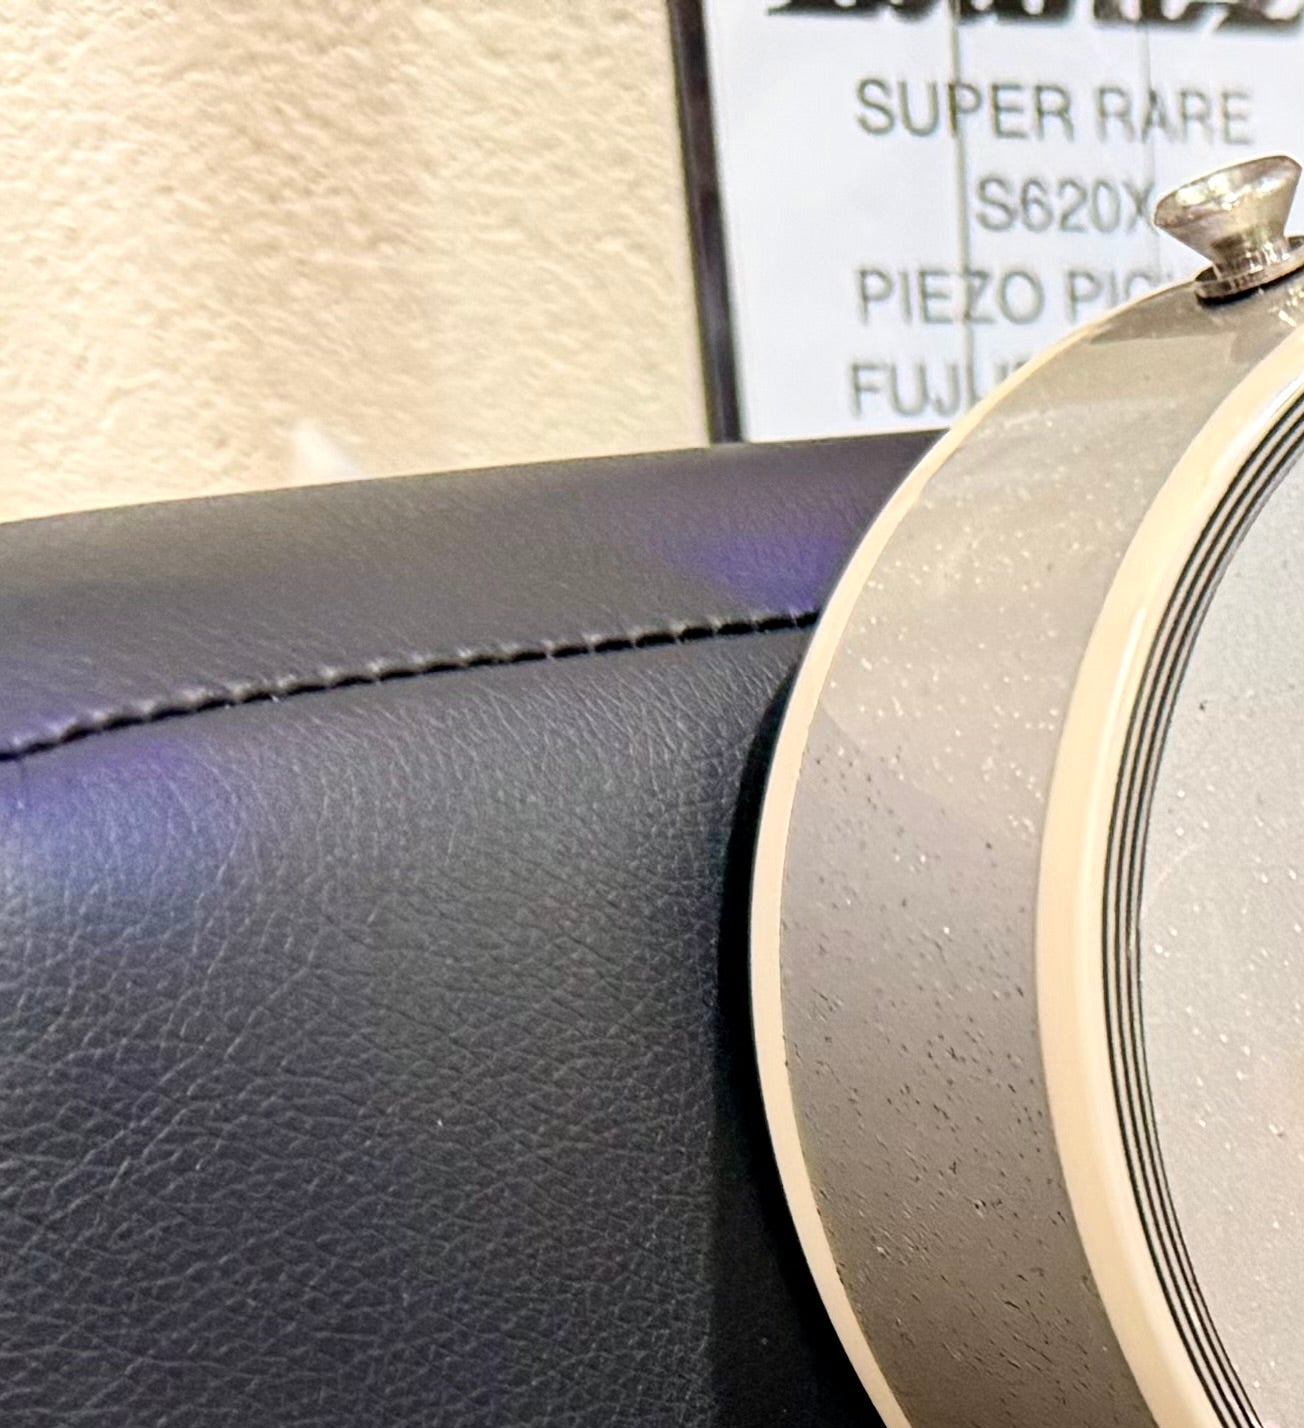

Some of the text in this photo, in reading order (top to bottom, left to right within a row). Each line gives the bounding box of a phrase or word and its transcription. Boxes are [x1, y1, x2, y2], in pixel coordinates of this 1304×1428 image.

[854, 77, 1256, 147] SUPER RARE
[975, 177, 1157, 234] S620X
[855, 267, 1046, 326] PIEZO
